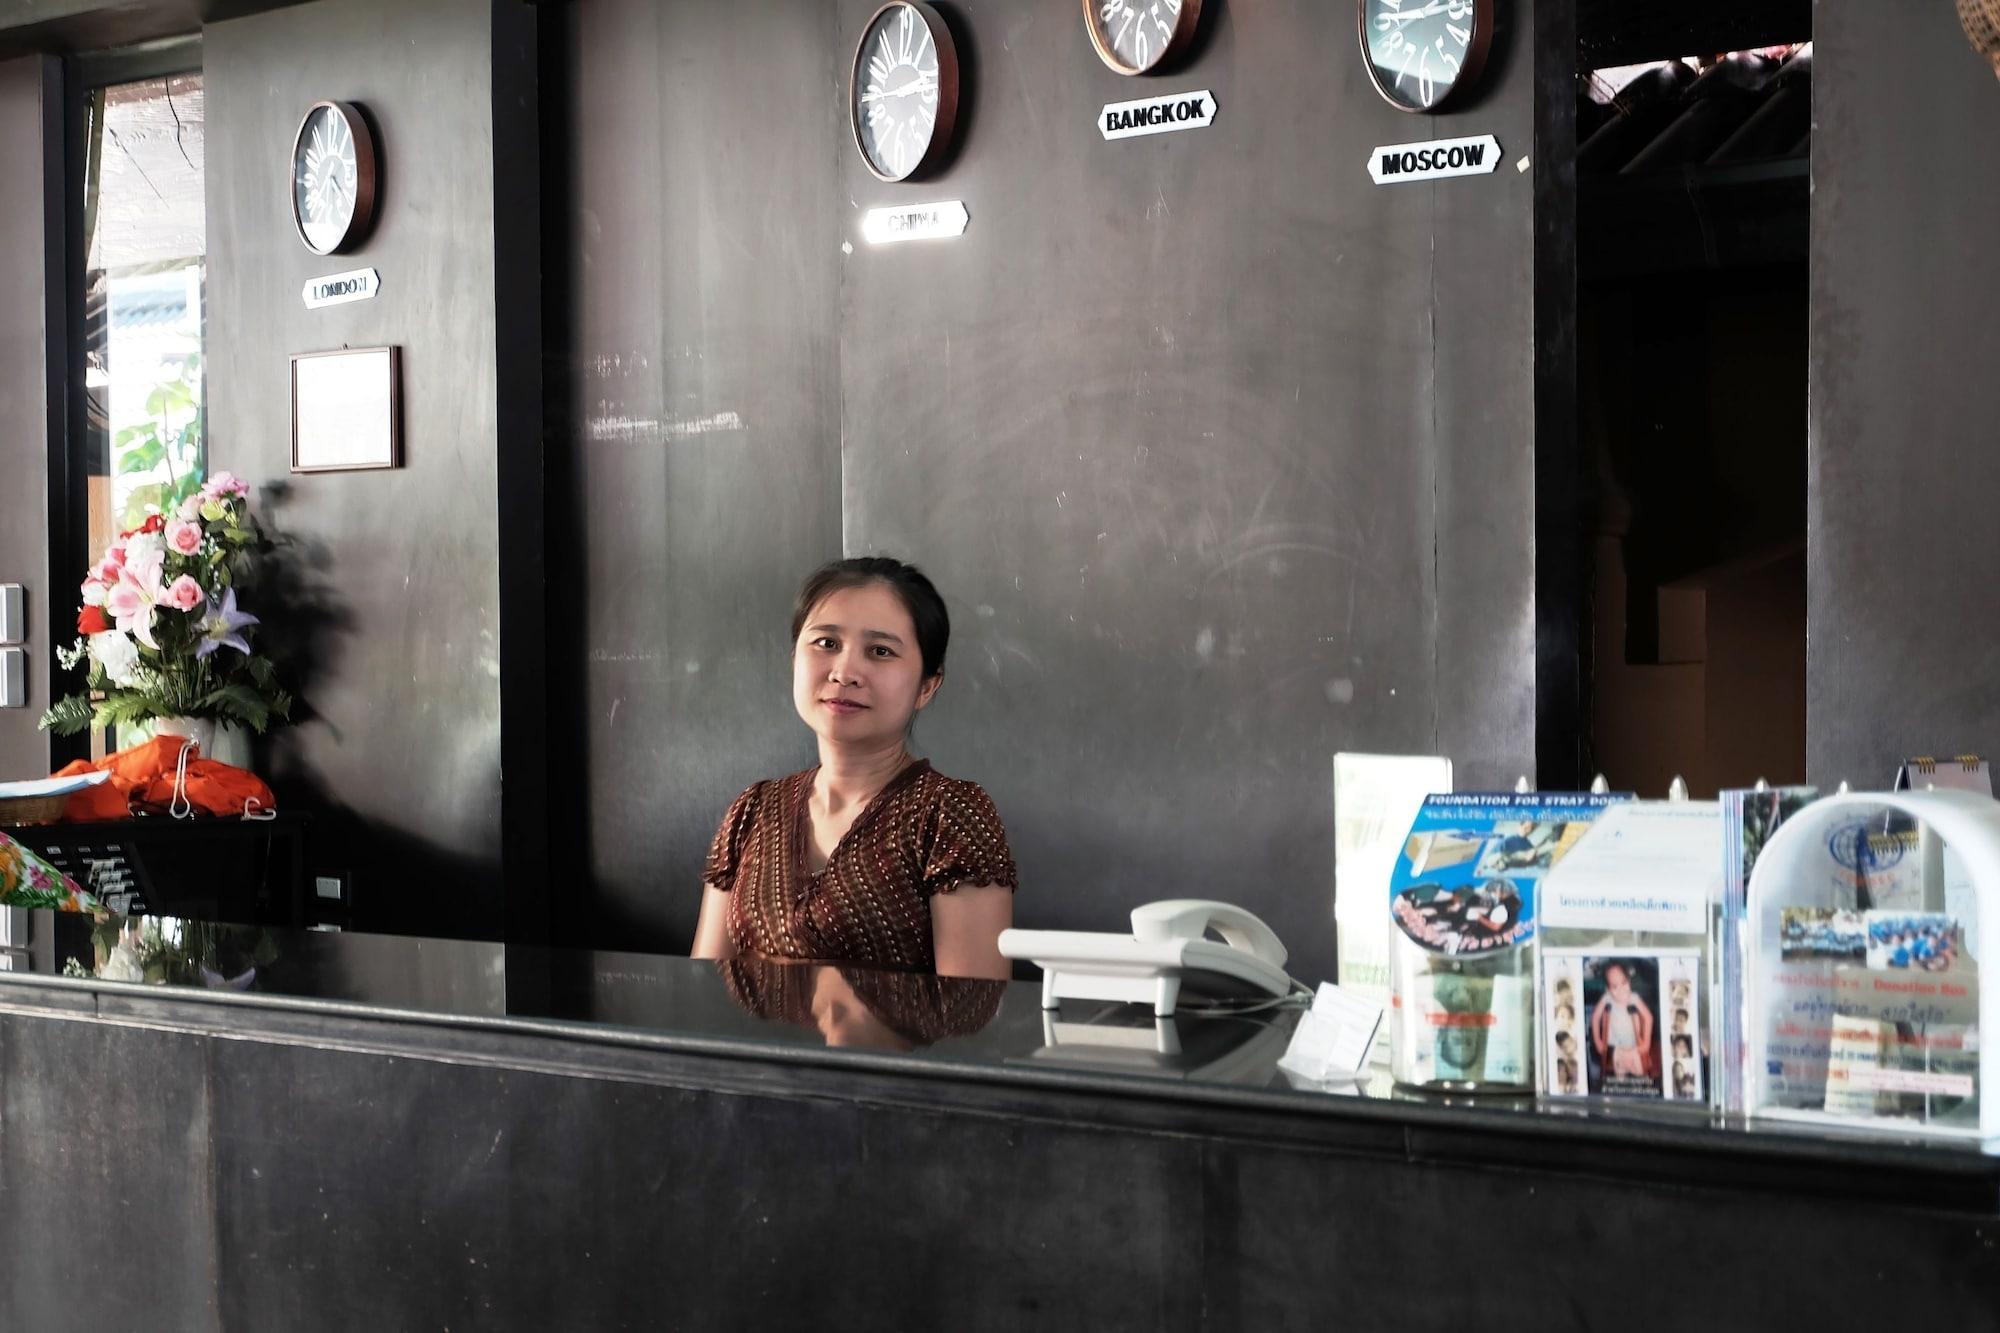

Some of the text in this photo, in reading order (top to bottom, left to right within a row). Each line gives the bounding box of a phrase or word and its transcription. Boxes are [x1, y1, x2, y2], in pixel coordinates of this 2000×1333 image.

[899, 5, 914, 65] 12
[1114, 7, 1134, 50] 7
[1135, 11, 1147, 71] 6
[1395, 42, 1416, 89] 7
[1419, 46, 1433, 107] 6
[1106, 99, 1205, 131] BANGKOK
[1382, 144, 1485, 175] MOSCOW
[313, 276, 367, 300] LONDON
[1429, 796, 1510, 806] FOUNDATION
[1515, 796, 1540, 806] FOR
[1545, 796, 1585, 806] STRAY
